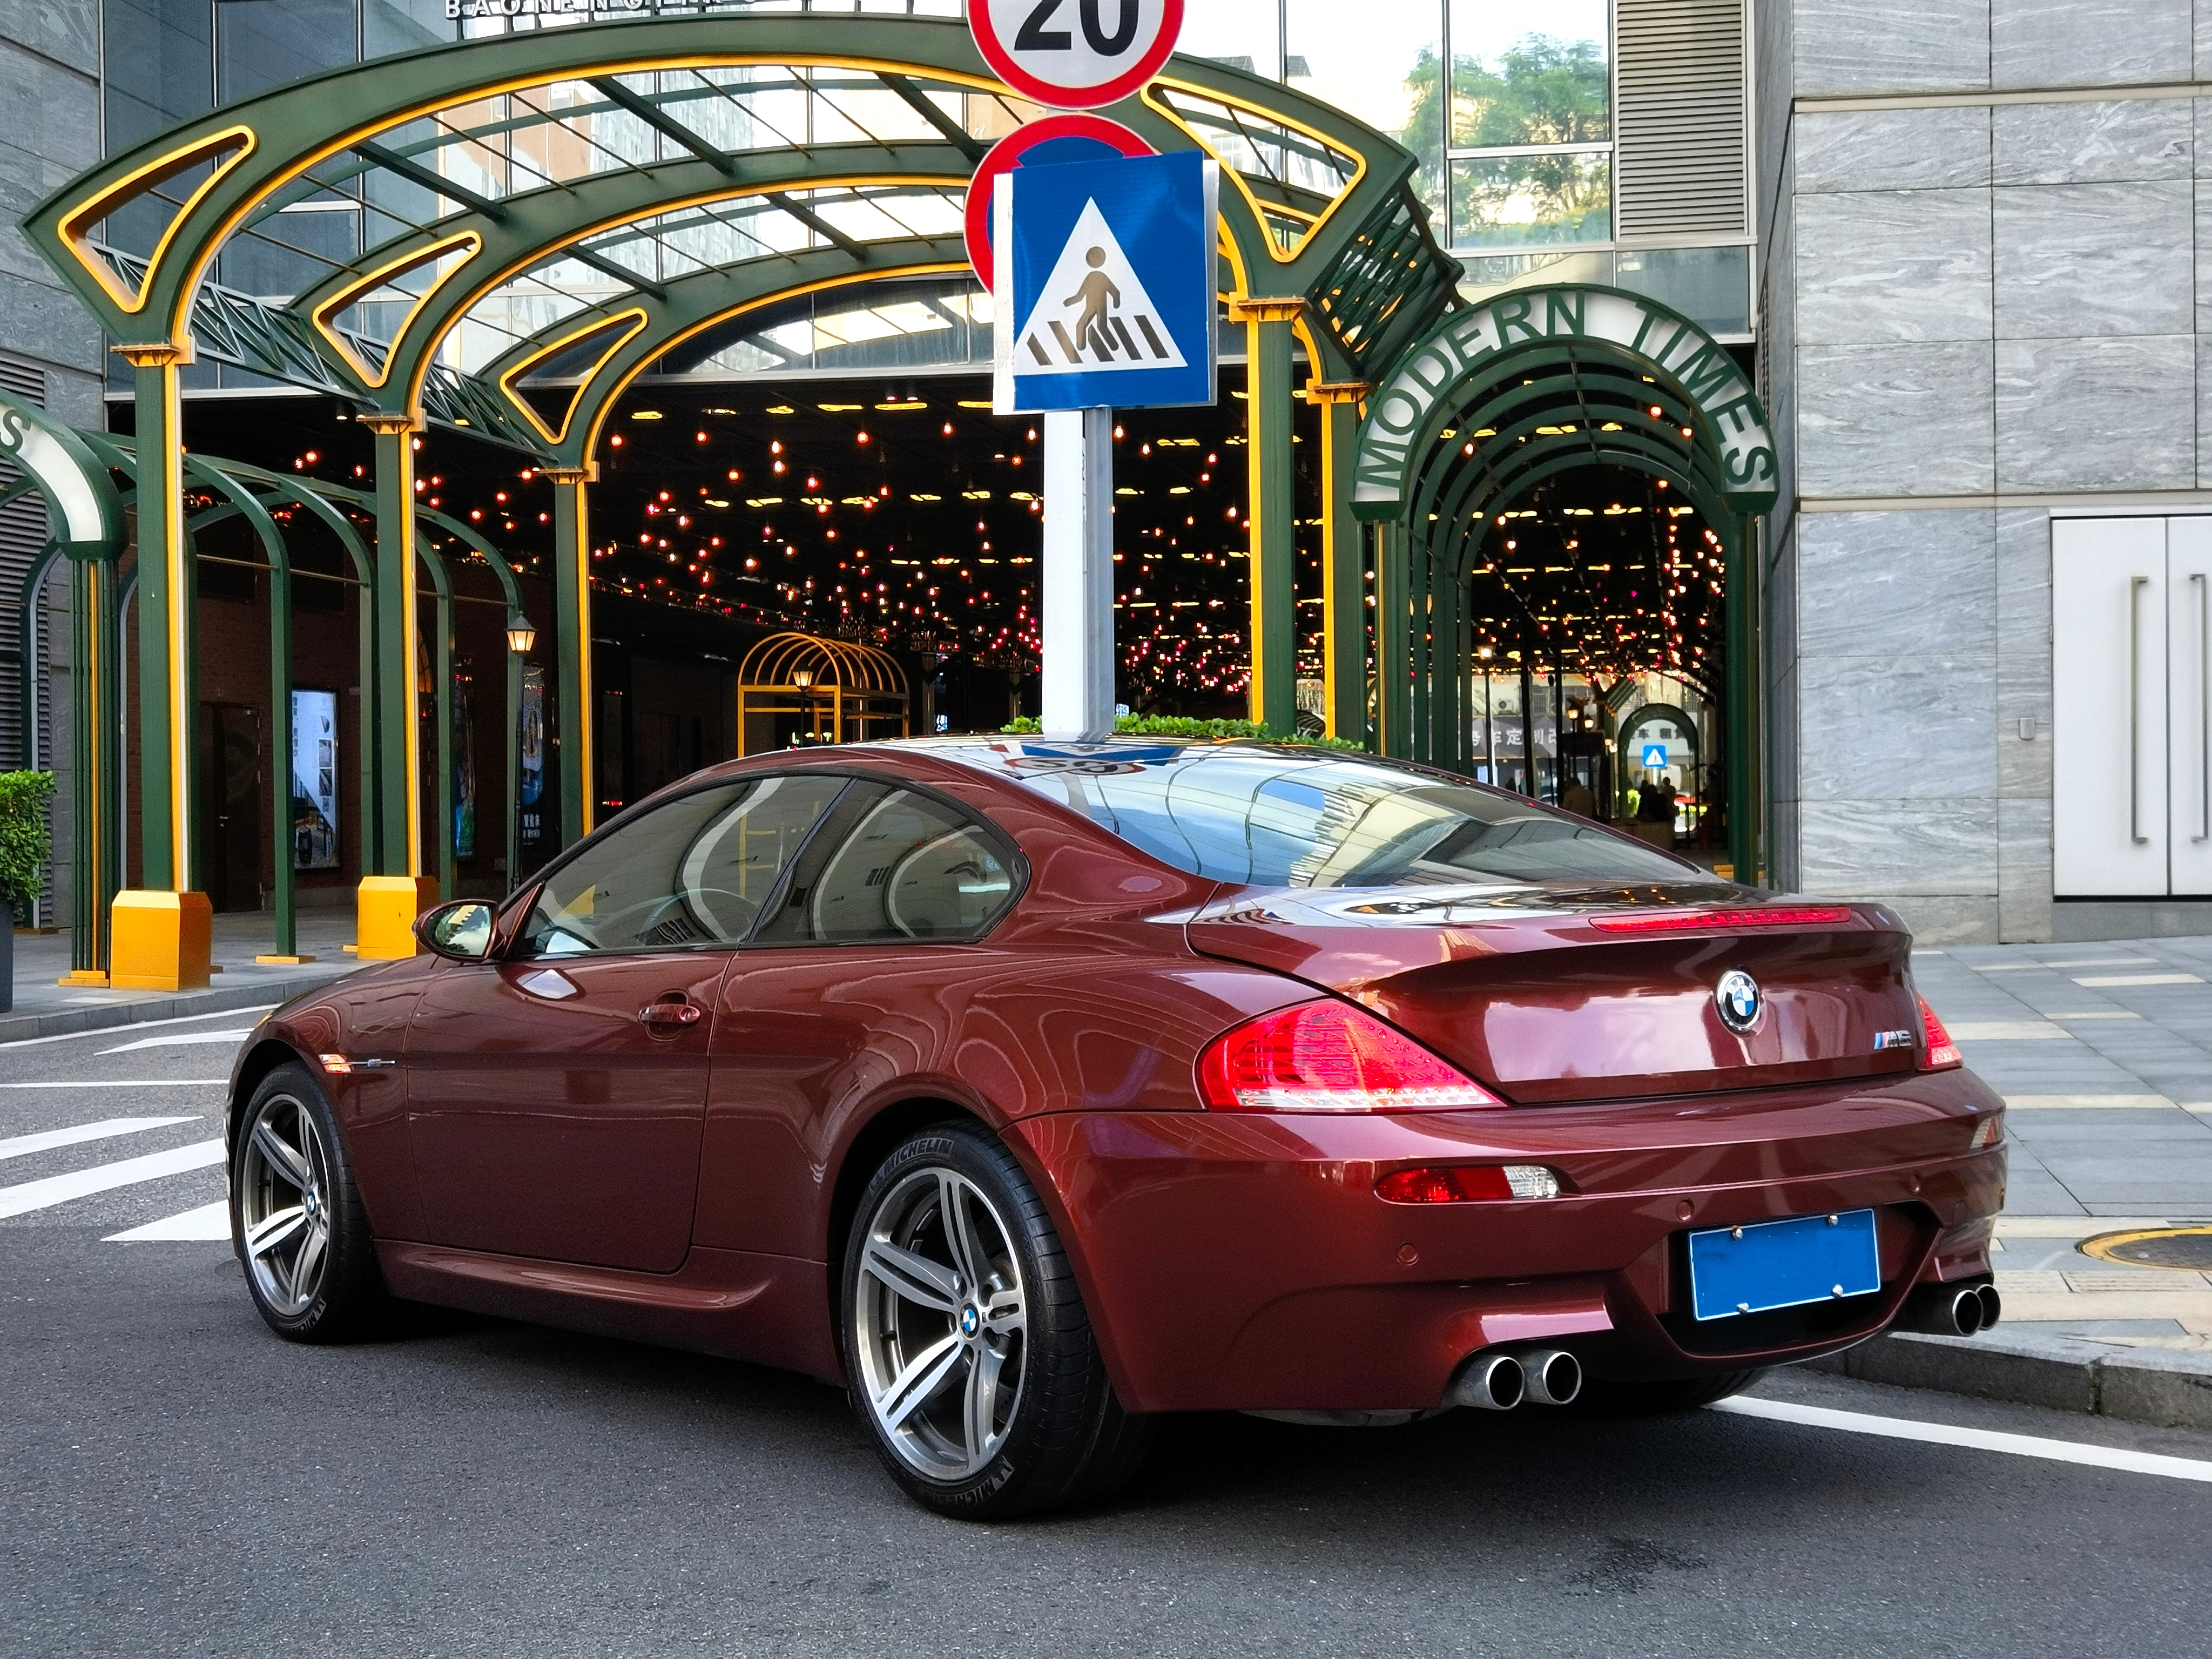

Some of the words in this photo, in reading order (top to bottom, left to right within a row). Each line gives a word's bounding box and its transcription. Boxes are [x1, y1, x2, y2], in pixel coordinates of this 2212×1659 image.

[1014, 0, 1138, 56] 20
[1354, 290, 1586, 500] MODERN
[1631, 299, 1774, 486] TIMES
[882, 1138, 954, 1178] MICHELIN
